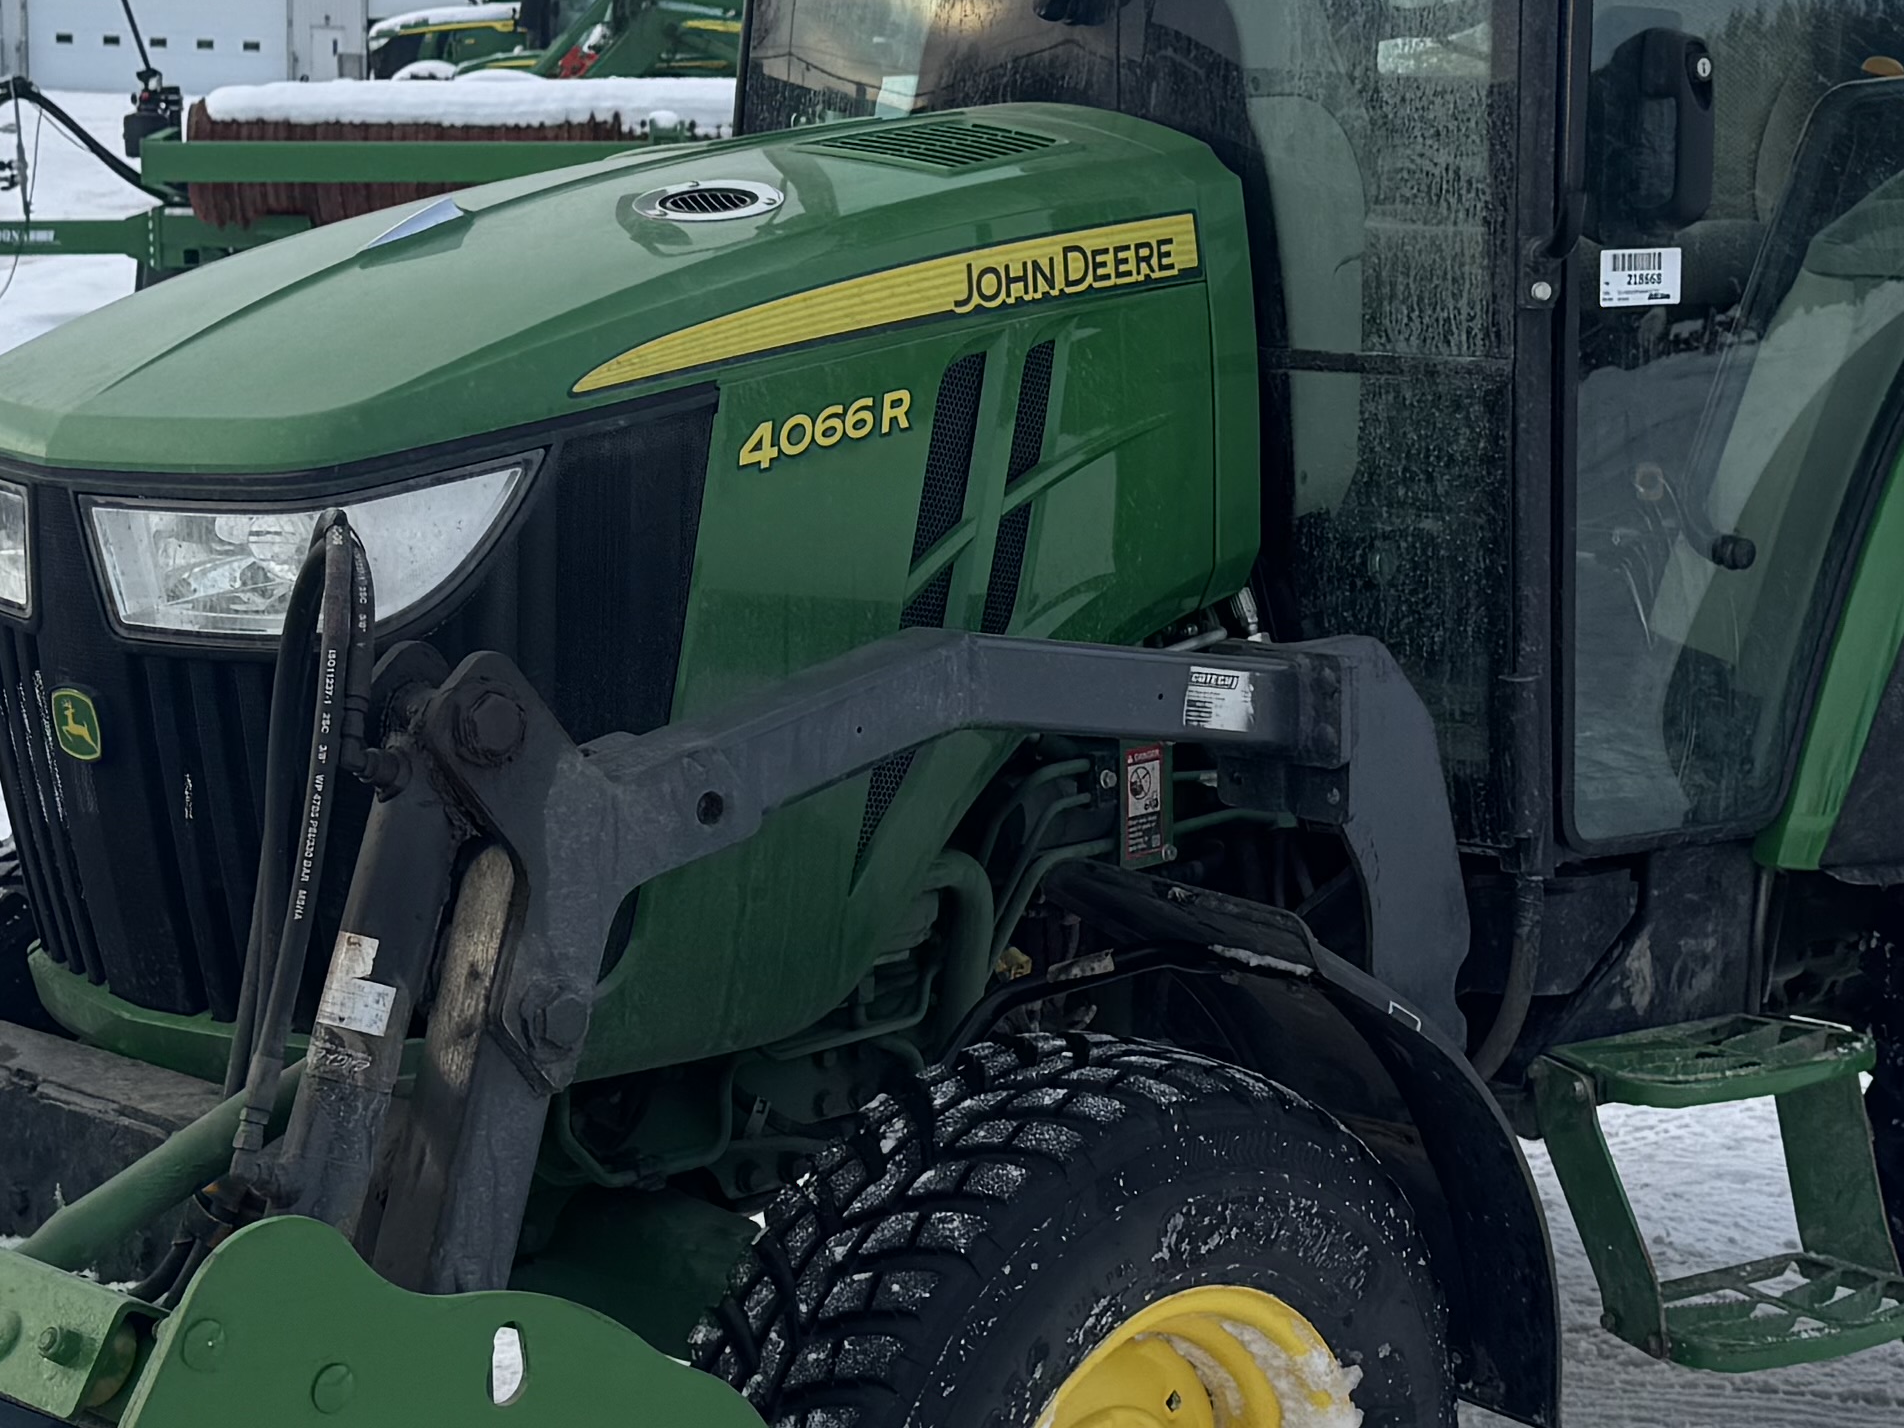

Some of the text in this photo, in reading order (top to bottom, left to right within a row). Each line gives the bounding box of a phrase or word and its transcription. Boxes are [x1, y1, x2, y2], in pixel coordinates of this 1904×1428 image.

[953, 237, 1176, 308] JOHN DEERE
[738, 388, 912, 470] 4066R
[1191, 673, 1235, 686] COTECH
